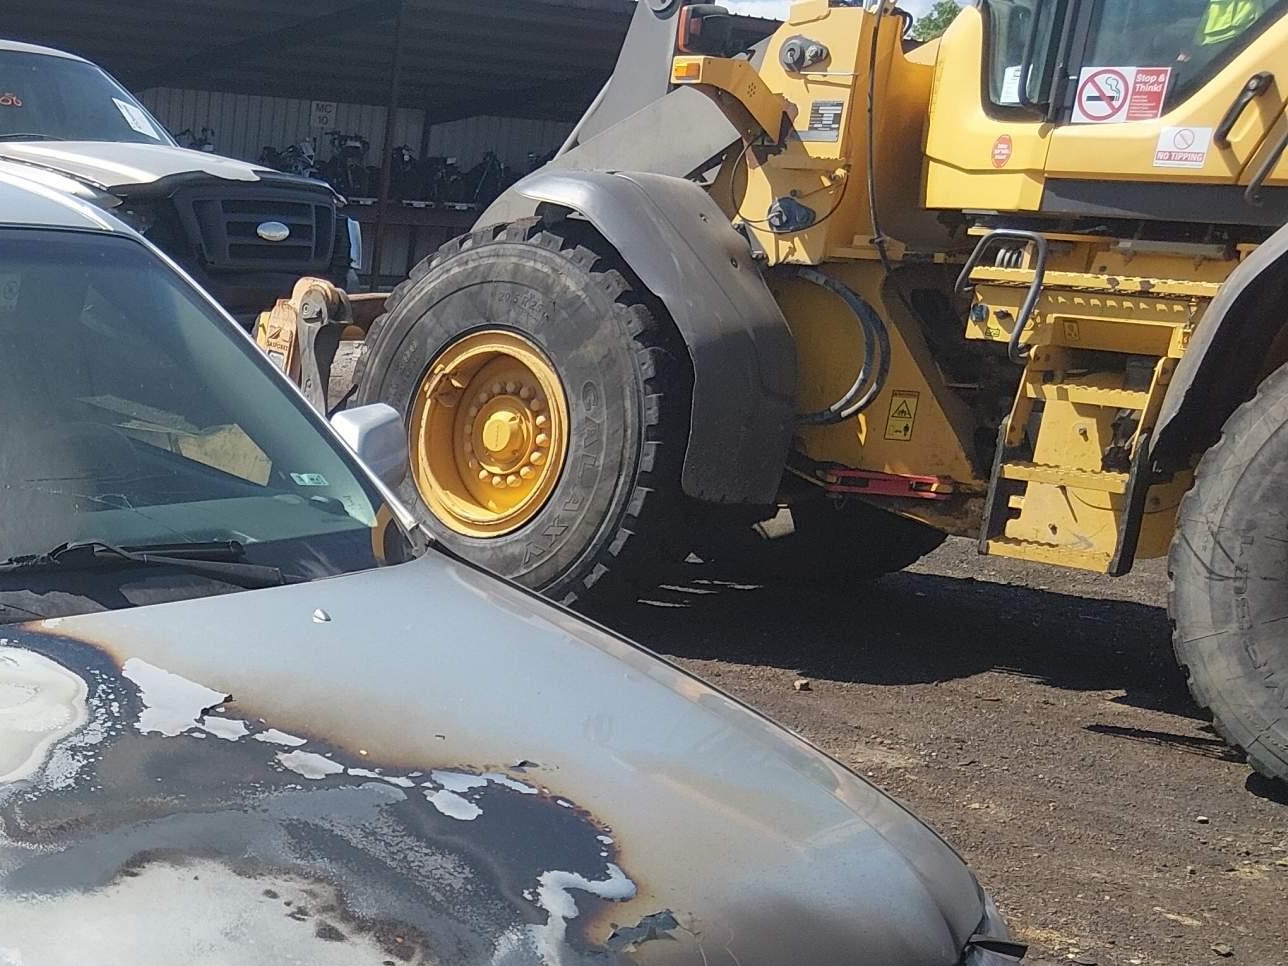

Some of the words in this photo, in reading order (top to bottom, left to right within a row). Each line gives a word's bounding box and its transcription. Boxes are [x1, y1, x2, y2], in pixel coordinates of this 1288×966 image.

[1136, 73, 1157, 85] Stop
[1159, 73, 1166, 83] &
[1135, 83, 1163, 92] Think!
[315, 103, 332, 113] MC
[1156, 151, 1170, 161] NO
[1170, 152, 1203, 162] TIPPING
